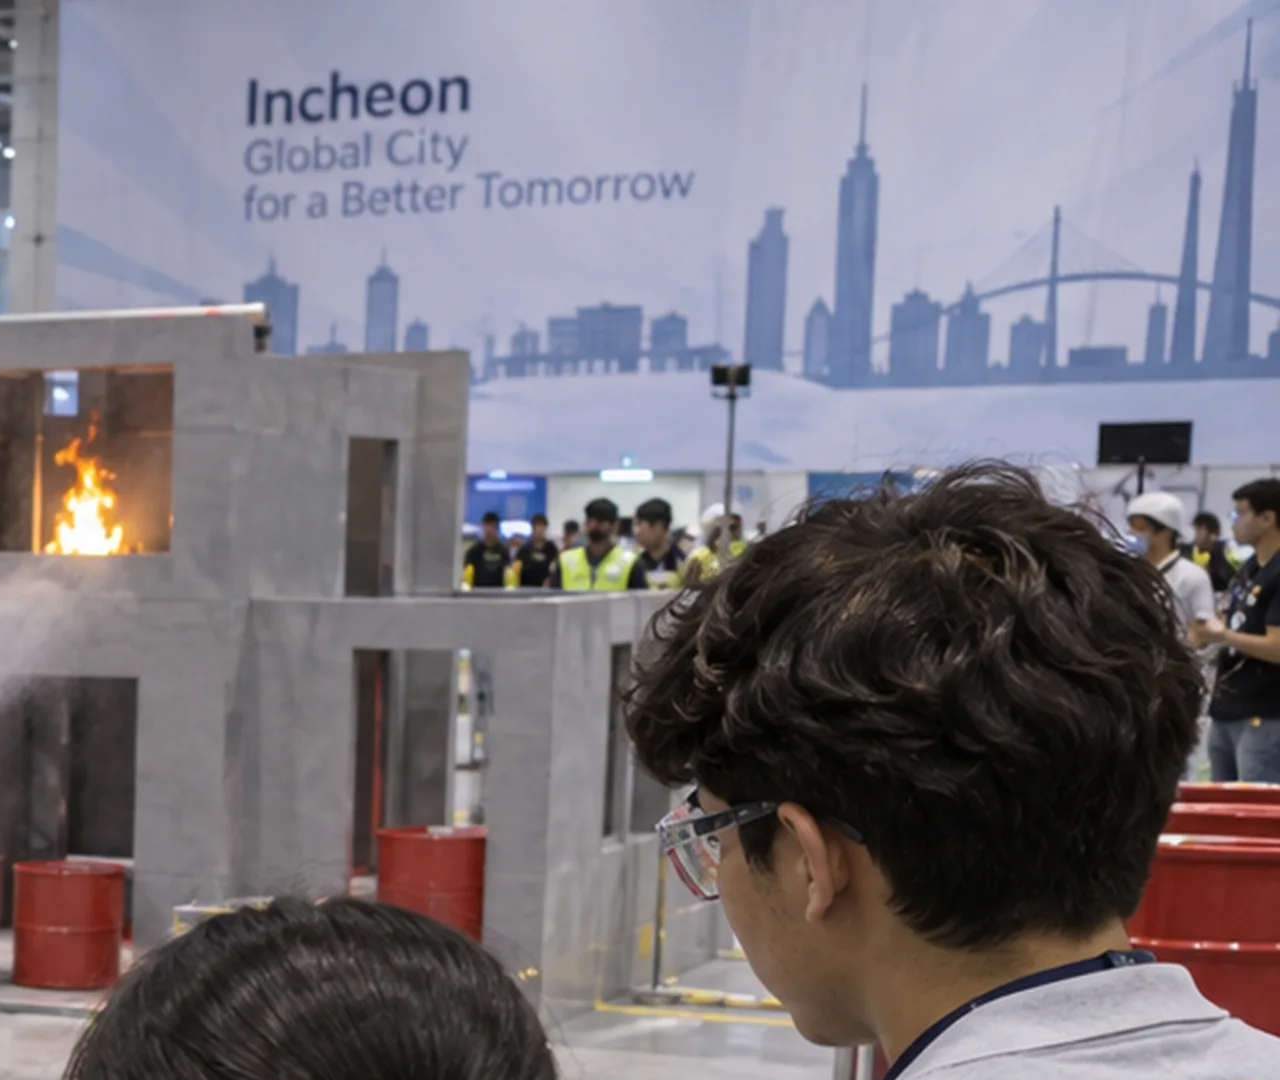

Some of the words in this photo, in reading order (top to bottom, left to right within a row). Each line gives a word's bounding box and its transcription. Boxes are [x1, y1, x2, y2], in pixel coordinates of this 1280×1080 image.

[246, 69, 470, 128] Incheon
[243, 130, 373, 176] Global
[385, 126, 469, 173] City
[243, 184, 297, 222] for
[306, 191, 328, 220] a
[342, 180, 465, 218] Better
[476, 169, 696, 210] Tomorrow
